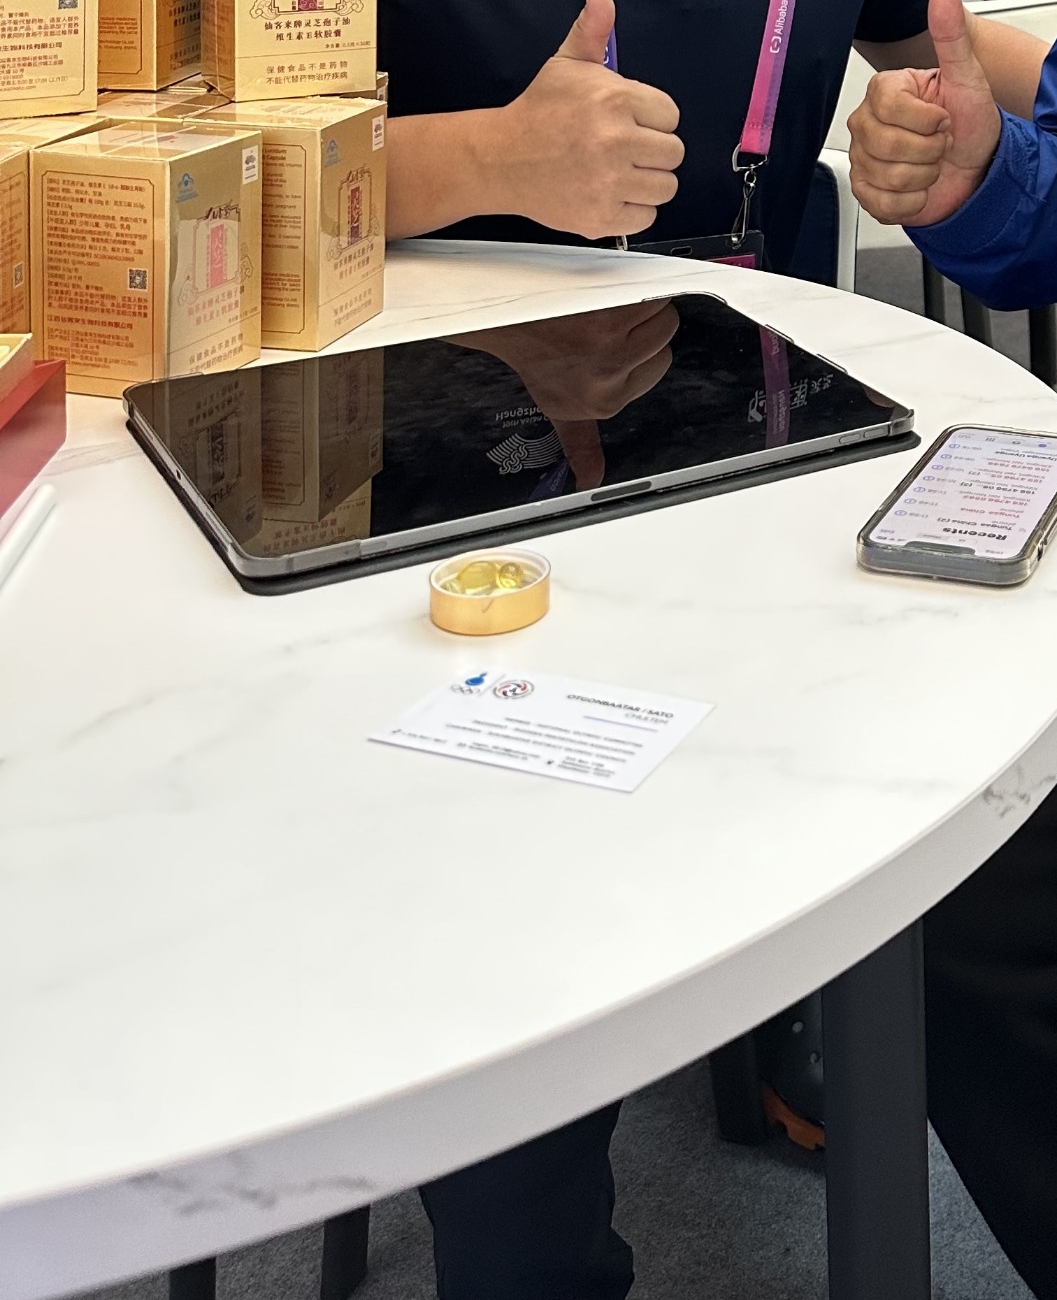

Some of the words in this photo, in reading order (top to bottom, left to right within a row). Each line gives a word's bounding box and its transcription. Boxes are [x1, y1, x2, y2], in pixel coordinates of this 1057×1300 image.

[774, 0, 788, 34] Alibaba
[266, 60, 348, 74] 保健食品不是药物
[266, 71, 348, 85] 不能代替药物治疗疾病
[942, 527, 1007, 541] Recents
[567, 694, 641, 712] OTGONBAATAR
[647, 708, 674, 718] SATO
